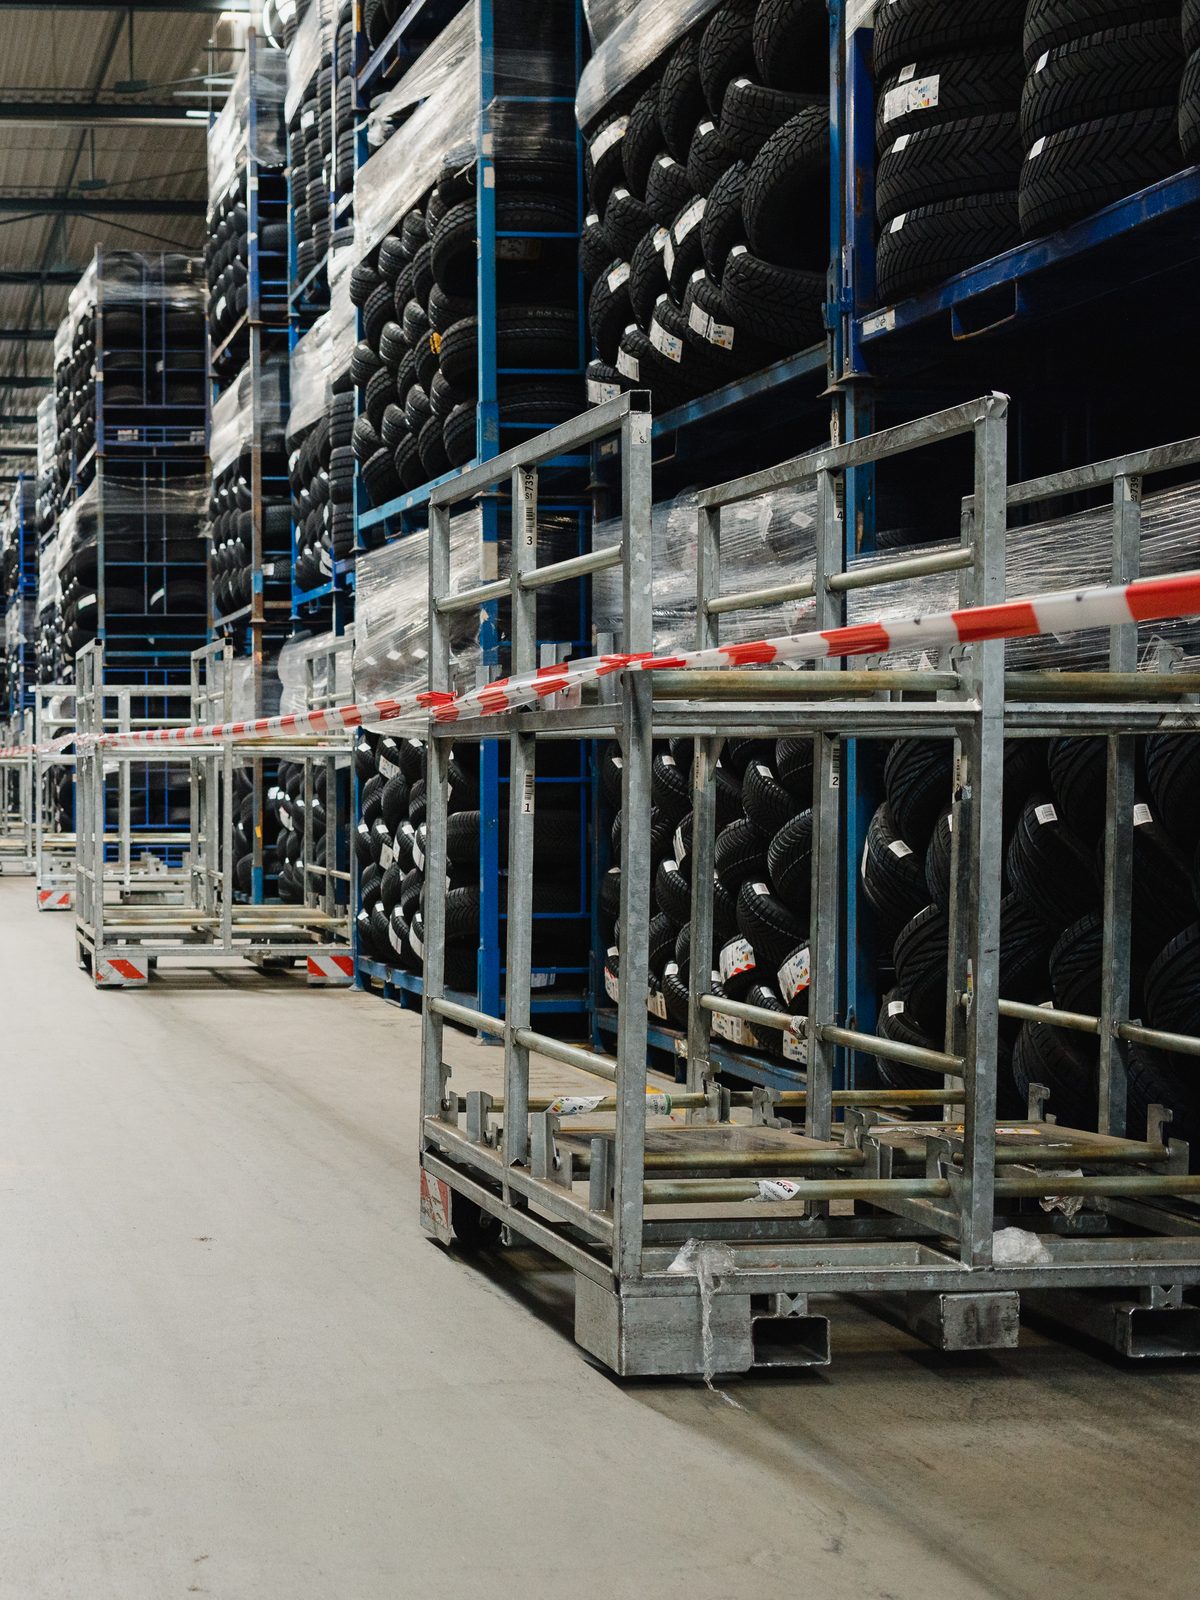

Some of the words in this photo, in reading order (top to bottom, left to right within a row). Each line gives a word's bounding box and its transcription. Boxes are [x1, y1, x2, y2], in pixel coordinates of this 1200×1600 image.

[525, 474, 534, 492] 739
[1130, 476, 1139, 494] 739
[525, 492, 533, 500] S1
[836, 511, 843, 520] 4
[526, 536, 533, 545] 3
[832, 776, 839, 786] 2
[524, 803, 531, 812] 1
